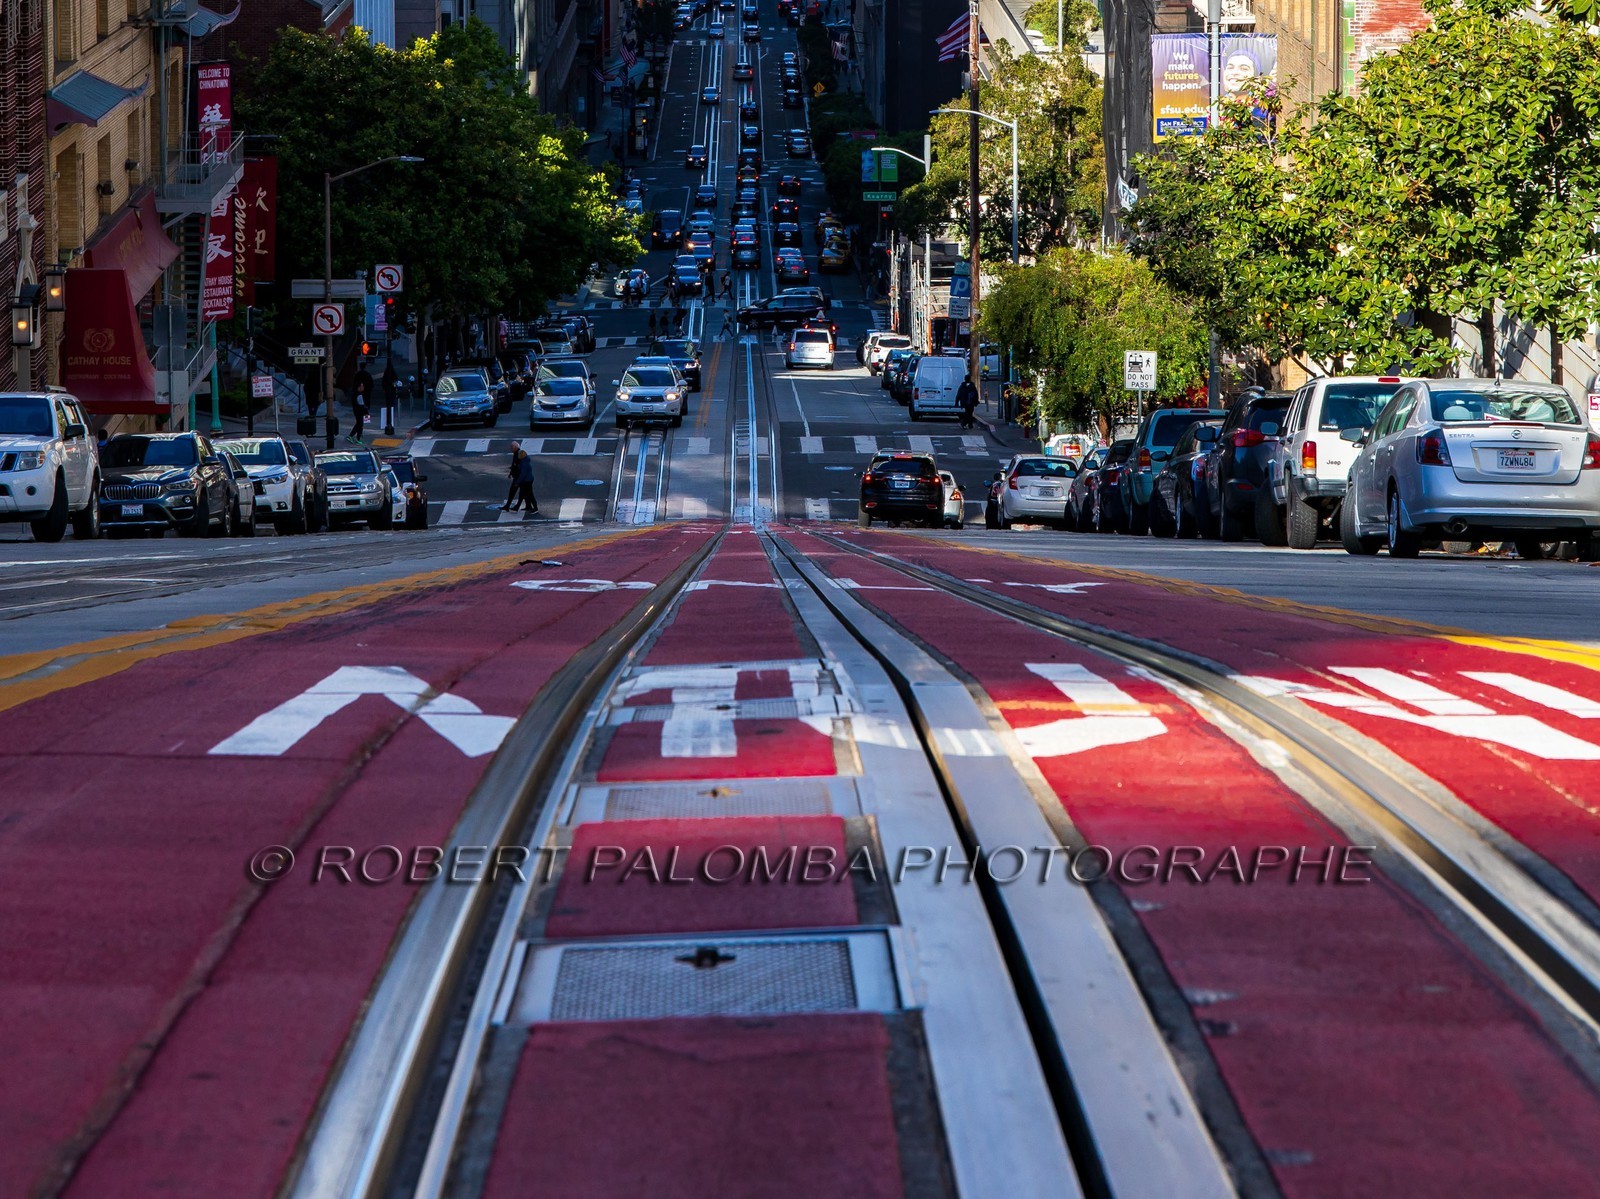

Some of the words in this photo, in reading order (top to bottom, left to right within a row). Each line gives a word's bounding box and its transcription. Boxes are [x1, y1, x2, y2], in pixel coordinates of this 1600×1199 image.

[1173, 52, 1189, 61] We
[1168, 62, 1195, 71] make
[198, 68, 222, 79] WELCOME
[223, 67, 231, 78] TO
[1164, 71, 1199, 80] futures
[199, 79, 229, 90] CHINATOWN
[1162, 82, 1202, 92] happen.
[1160, 104, 1204, 115] sfsu.edu
[217, 275, 233, 286] HOUSE
[203, 286, 233, 298] ESTAURANT
[203, 298, 227, 309] OCKTAILS
[67, 355, 100, 366] CATHAY
[103, 355, 132, 366] HOUSE
[1499, 456, 1535, 467] 7ZWN484
